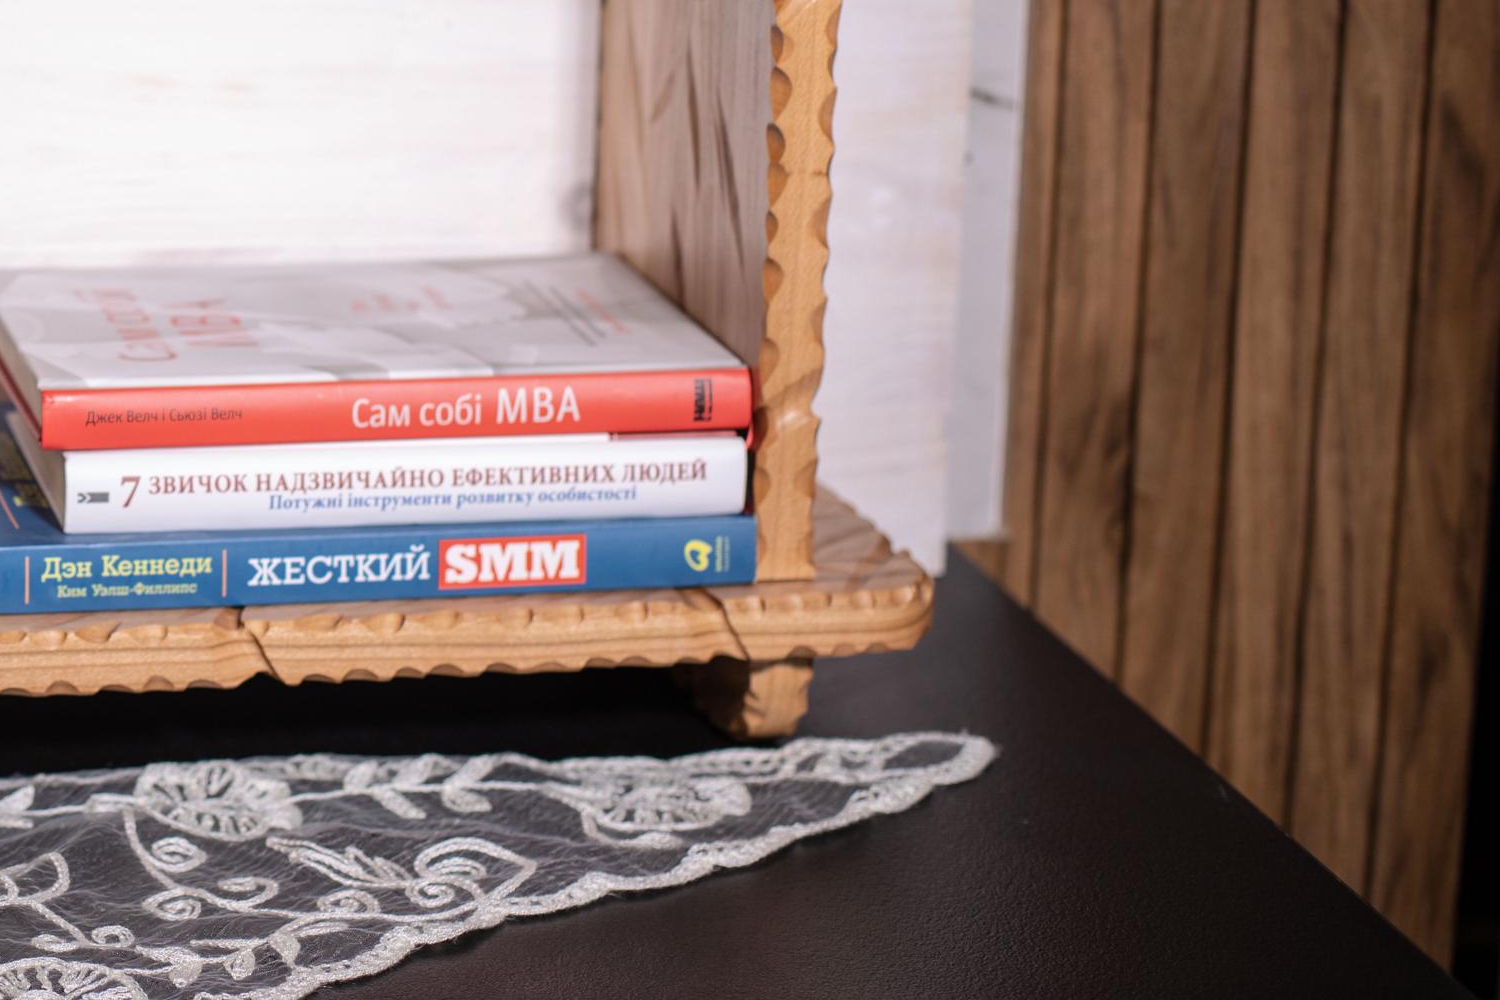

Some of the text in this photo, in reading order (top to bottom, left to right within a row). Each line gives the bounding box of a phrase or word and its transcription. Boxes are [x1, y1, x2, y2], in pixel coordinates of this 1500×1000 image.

[86, 410, 123, 427] Джек
[126, 409, 158, 423] Велч
[169, 407, 206, 422] Сьюзі
[211, 407, 243, 420] Велч
[351, 398, 411, 429] Сам
[419, 393, 482, 427] собі
[120, 458, 707, 509] 7 ЗВИЧОК НАДЗВИЧАЙНО ЕФЕКТИВНИХ ЛЮДЕЙ
[268, 486, 636, 511] Потужні інструменти розвитку особистості
[41, 554, 212, 583] Дэн Кеннеди
[247, 544, 431, 587] ЖЕСТКИЙ
[444, 539, 580, 584] SMM
[57, 582, 198, 599] Ким Уэлш-Филлипс
